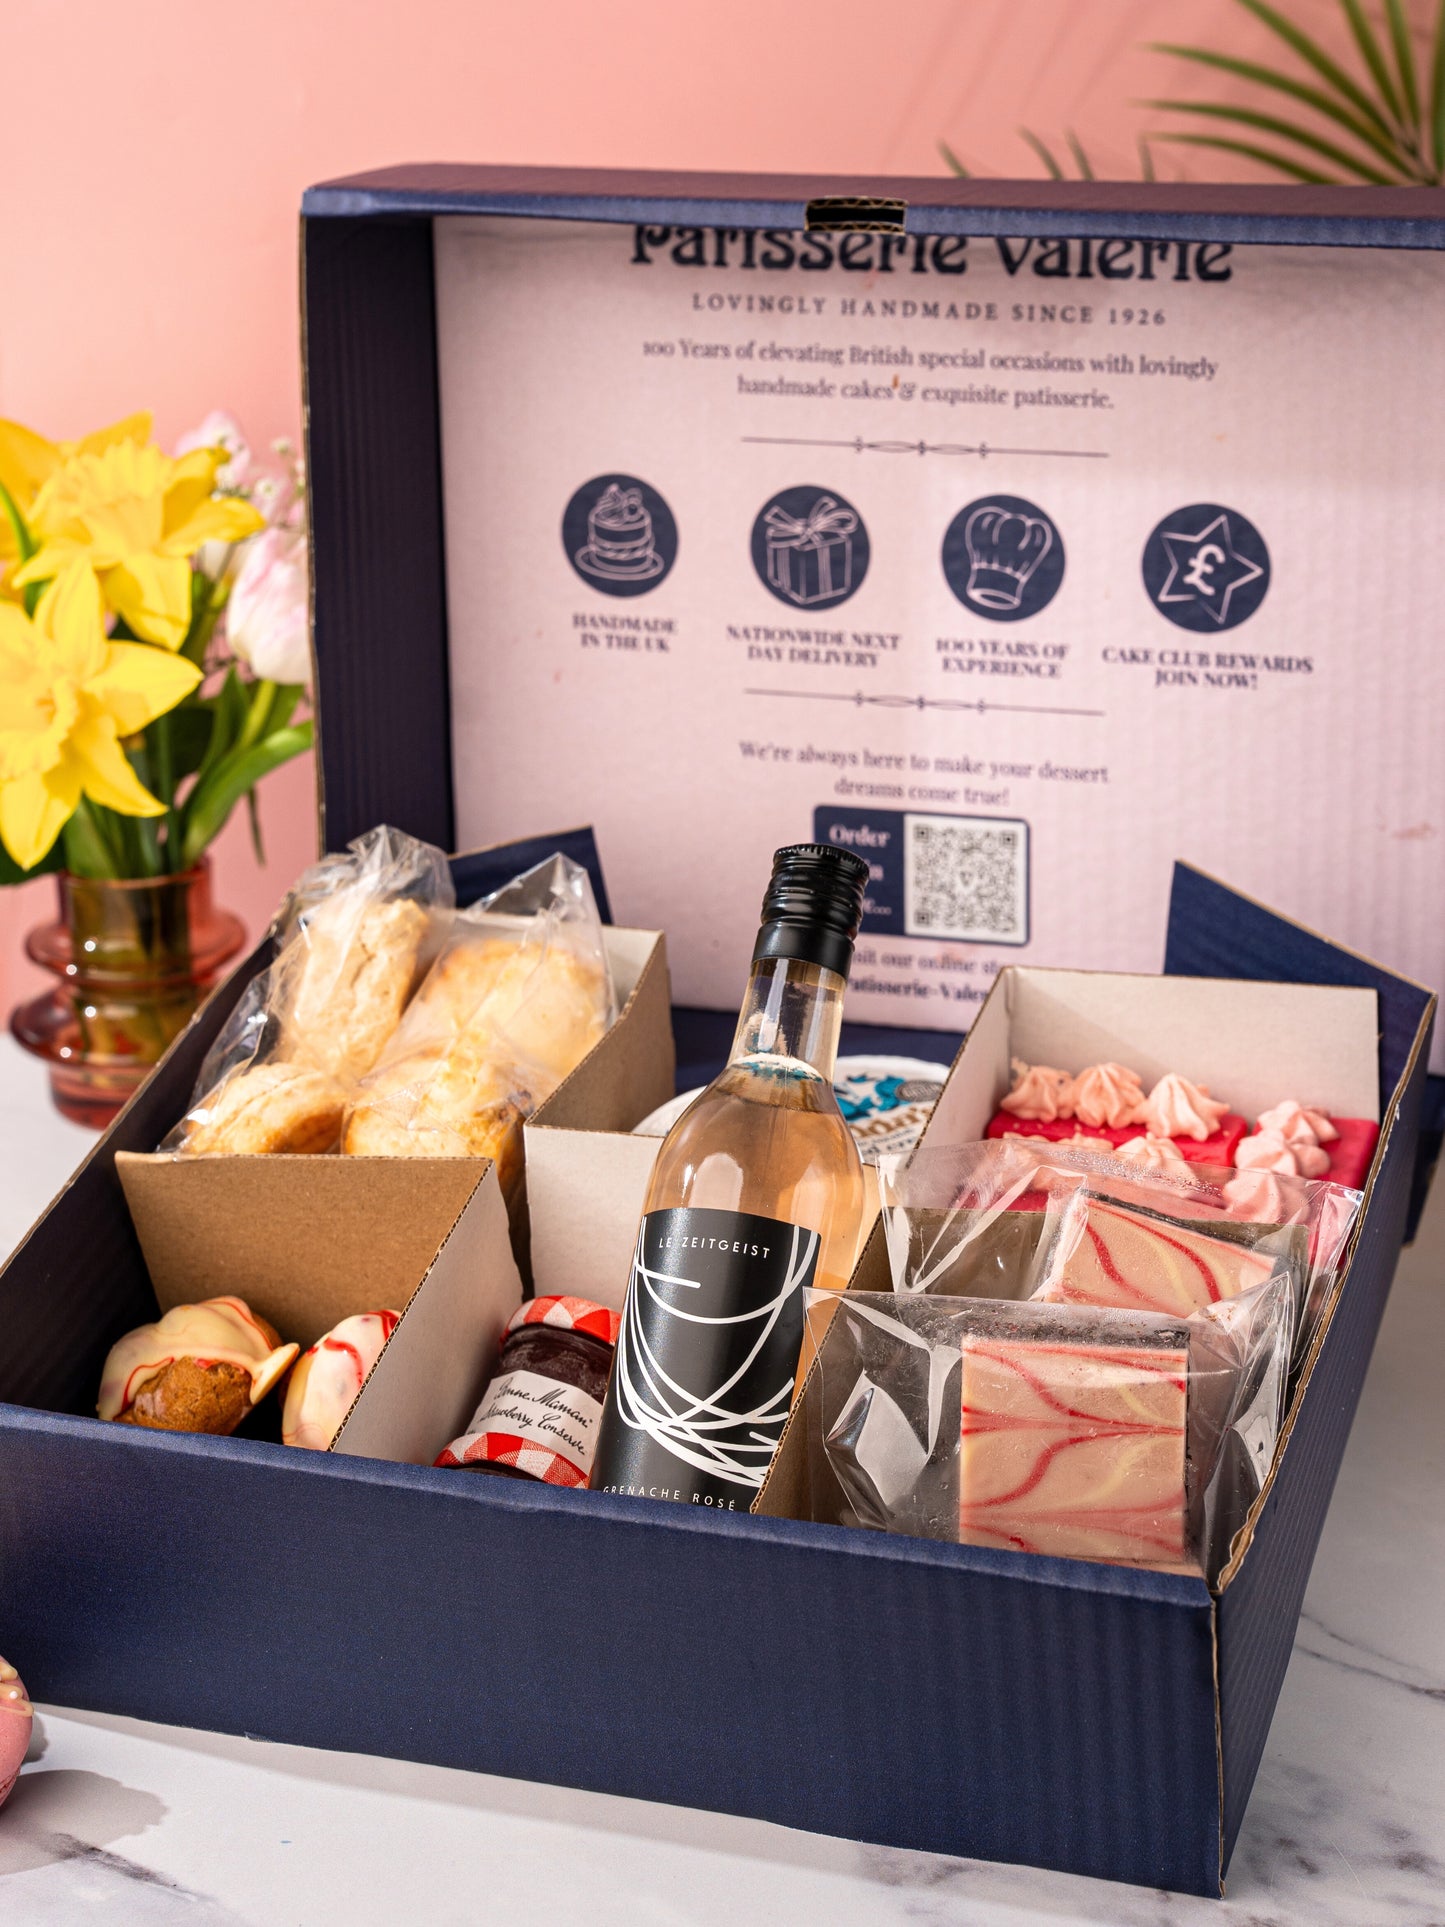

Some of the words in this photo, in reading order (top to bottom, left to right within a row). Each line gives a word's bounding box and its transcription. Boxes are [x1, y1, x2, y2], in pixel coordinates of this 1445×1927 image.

[692, 292, 827, 314] LOVINGLY
[841, 297, 998, 320] HANDMADE
[1011, 303, 1093, 324] SINCE
[1109, 308, 1166, 326] 1926
[679, 338, 731, 359] Years
[735, 339, 756, 359] of
[759, 341, 845, 366] elevating
[849, 344, 914, 367] British
[919, 348, 985, 370] special
[990, 351, 1085, 373] occasions
[1089, 353, 1134, 375] with
[1139, 354, 1219, 381] lovingly
[737, 374, 836, 397] handmade
[840, 379, 894, 401] cakes
[921, 383, 1008, 407] exquisite
[1013, 385, 1115, 409] patisserie.
[572, 613, 678, 634] HANDMADE
[581, 633, 599, 648] IN
[605, 634, 639, 650] THE
[645, 636, 670, 652] UK
[727, 624, 845, 646] NATIONWIDE
[851, 632, 901, 651] NEXT
[978, 640, 1039, 659] YEARS
[1043, 643, 1070, 661] OF
[747, 645, 783, 662] DAY
[788, 648, 881, 668] DELIVERY
[942, 656, 1062, 679] EXPERIENCE
[1102, 646, 1152, 665] CAKE
[1158, 649, 1211, 667] CLUB
[1215, 653, 1314, 675] REWARDS
[1155, 669, 1198, 688] JOIN
[1203, 672, 1258, 690] NOW!
[738, 740, 792, 762] We're
[796, 746, 858, 768] always
[863, 750, 905, 770] here
[910, 753, 931, 771] to
[935, 755, 985, 775] make
[989, 760, 1032, 779] your
[1038, 761, 1110, 783] dessert
[834, 776, 904, 798] dreams
[908, 784, 958, 802] come
[964, 785, 1010, 806] true!
[828, 822, 891, 848] Order
[658, 1237, 672, 1249] LE
[681, 1236, 771, 1259] ZEITGEIST
[602, 1485, 681, 1501] GRENACHE
[692, 1492, 737, 1512] ROSÉ
